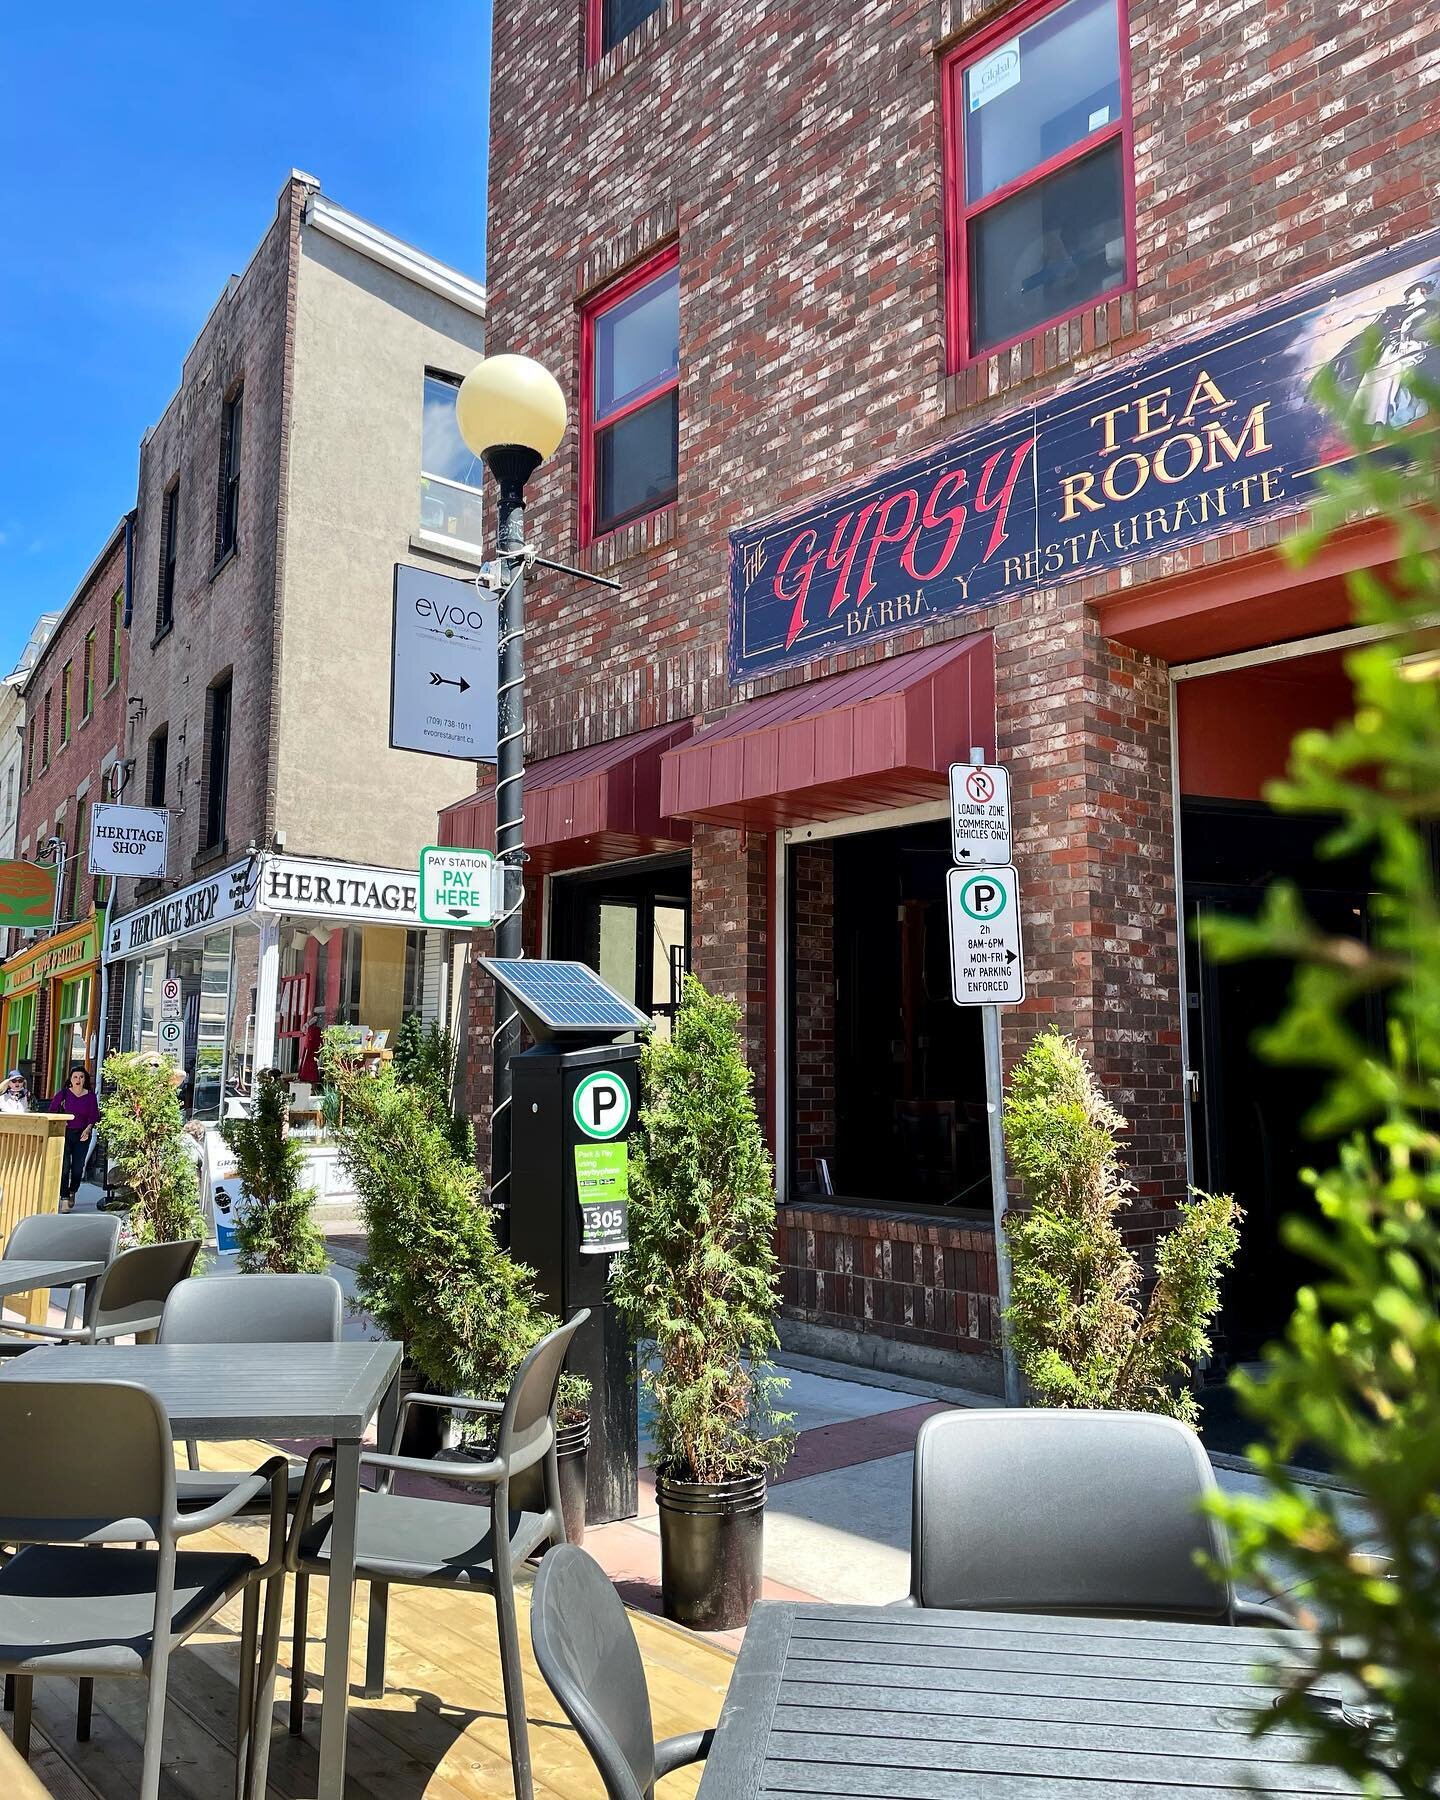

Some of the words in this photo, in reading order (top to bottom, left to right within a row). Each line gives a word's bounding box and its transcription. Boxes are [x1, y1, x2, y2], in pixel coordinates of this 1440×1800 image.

[1089, 370, 1237, 457] TEA
[1058, 401, 1273, 523] ROOM
[773, 433, 1043, 651] GYPSY
[847, 588, 931, 636] BARRA
[952, 563, 980, 599] Y
[1003, 466, 1285, 586] RESTAURANTE
[743, 536, 768, 594] THE
[416, 598, 483, 629] evoo
[426, 716, 442, 727] (709)
[444, 719, 471, 731] 738-1011
[423, 729, 474, 744] evoorestaurant.ca
[957, 803, 985, 816] LOADING
[988, 805, 1005, 816] ZONE
[958, 819, 1006, 831] COMMERCIAL
[96, 825, 164, 843] HERITAGE
[956, 829, 989, 840] VEHICLES
[991, 830, 1008, 841] ONLY
[112, 841, 146, 855] SHOP
[428, 856, 446, 866] PAY
[448, 858, 487, 868] STATION
[443, 870, 473, 887] PAY
[268, 871, 417, 914] HERITAGE
[436, 889, 480, 907] HERE
[974, 885, 995, 911] P
[129, 899, 183, 949] HERITAGE
[183, 883, 219, 928] SHOP
[980, 925, 990, 934] 2h
[968, 938, 1004, 949] 8AM-6PM
[970, 952, 1003, 963] MON-FRI
[963, 967, 976, 977] PAY
[980, 966, 1012, 977] PARKING
[968, 981, 1009, 992] ENFORCED
[592, 1086, 618, 1126] P
